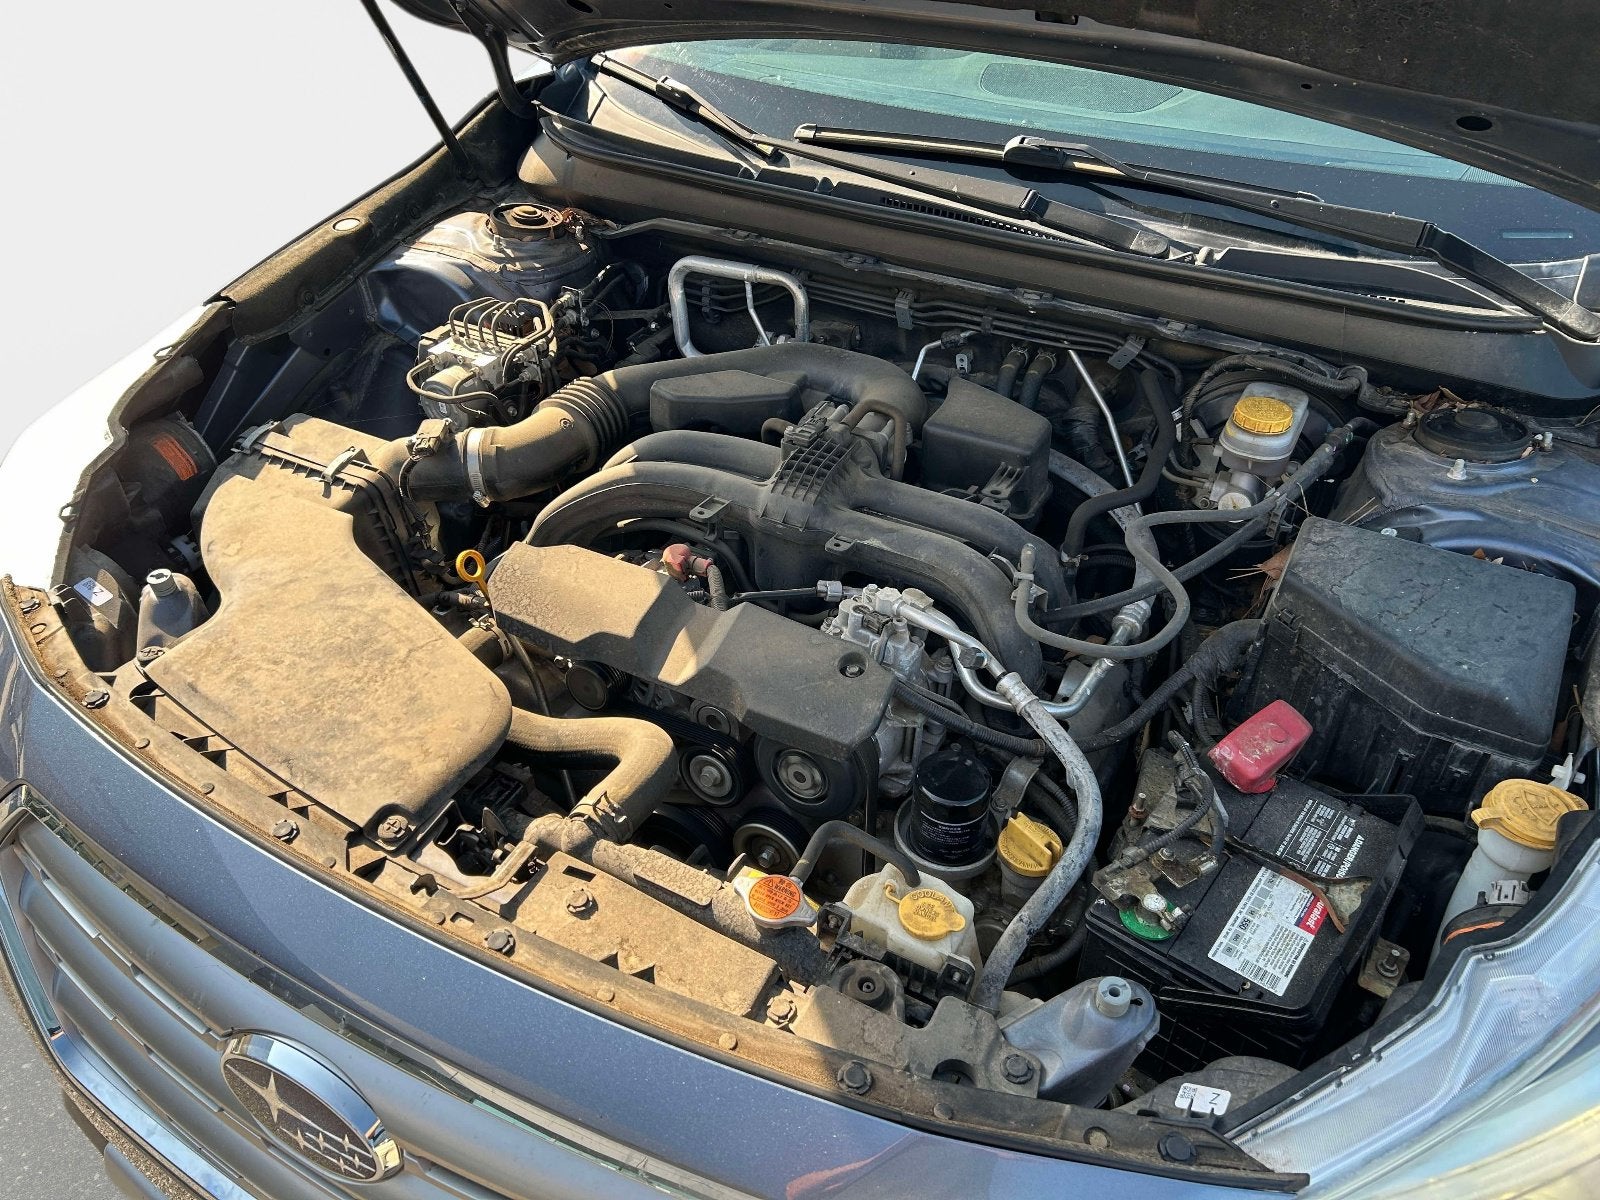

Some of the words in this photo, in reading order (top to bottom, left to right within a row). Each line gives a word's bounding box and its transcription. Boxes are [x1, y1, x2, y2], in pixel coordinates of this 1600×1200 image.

[1336, 840, 1364, 878] DANGER/POISO
[774, 884, 797, 897] WARNING
[911, 890, 955, 912] COOLANT
[1239, 918, 1251, 931] 550
[1209, 1092, 1221, 1105] Z
